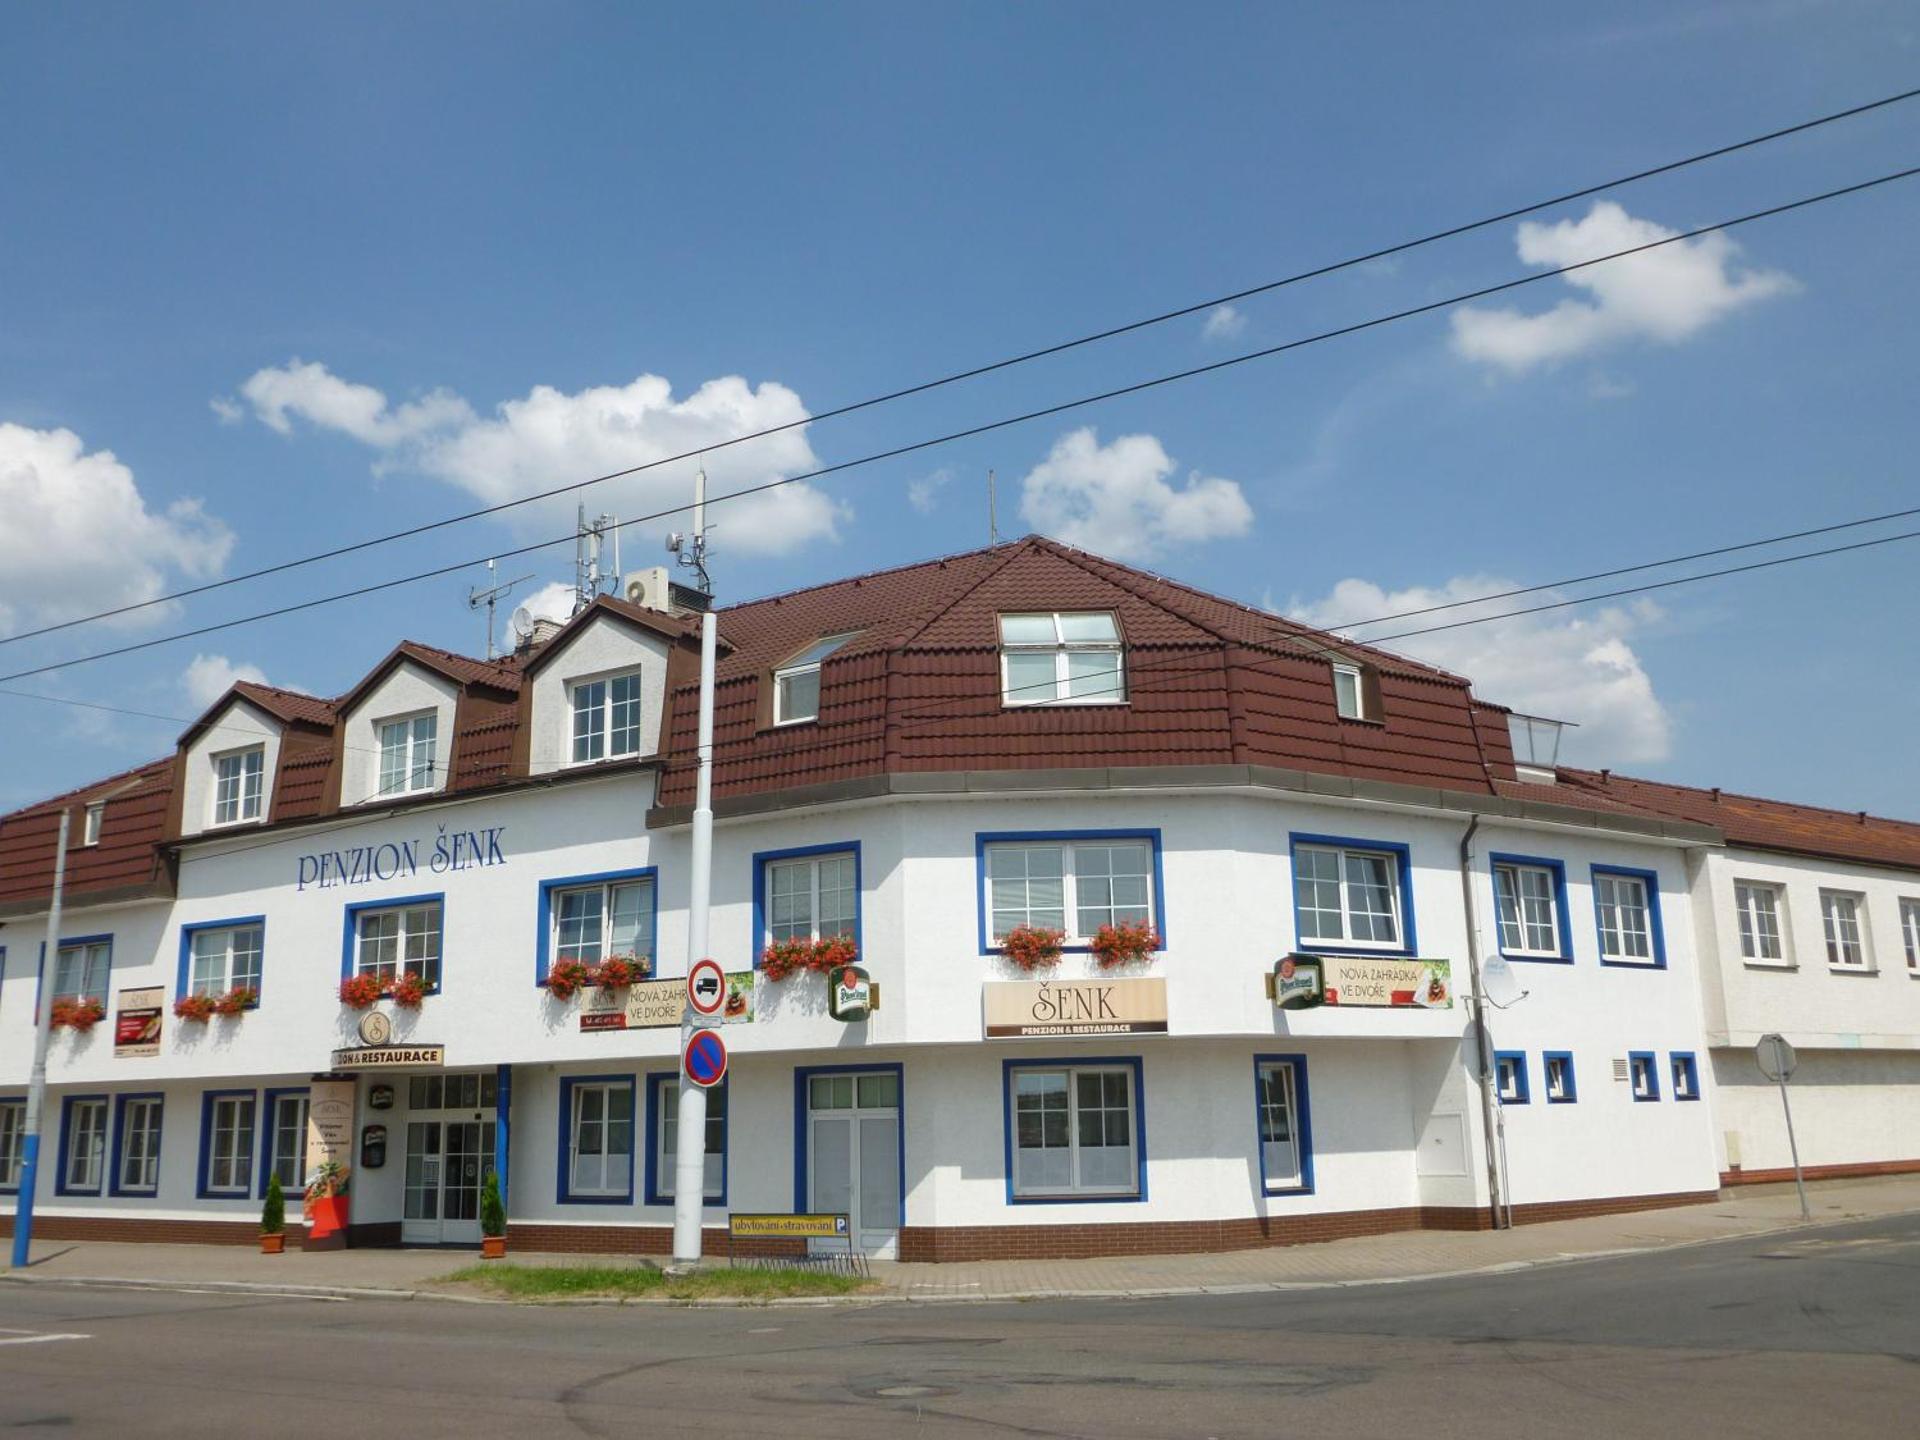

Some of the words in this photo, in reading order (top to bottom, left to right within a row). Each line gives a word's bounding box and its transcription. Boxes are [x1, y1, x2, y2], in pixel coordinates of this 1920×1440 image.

[297, 839, 420, 891] PENZION
[430, 823, 507, 874] ŠENK
[1341, 985, 1353, 996] VE
[1032, 981, 1119, 1021] ŠENK
[631, 1007, 643, 1018] VE
[645, 1003, 676, 1018] DVOŘE
[1021, 1025, 1064, 1035] PENZION
[1065, 1026, 1071, 1035] &
[1073, 1024, 1131, 1035] RESTAURACE
[361, 1050, 438, 1064] RESTAURACE
